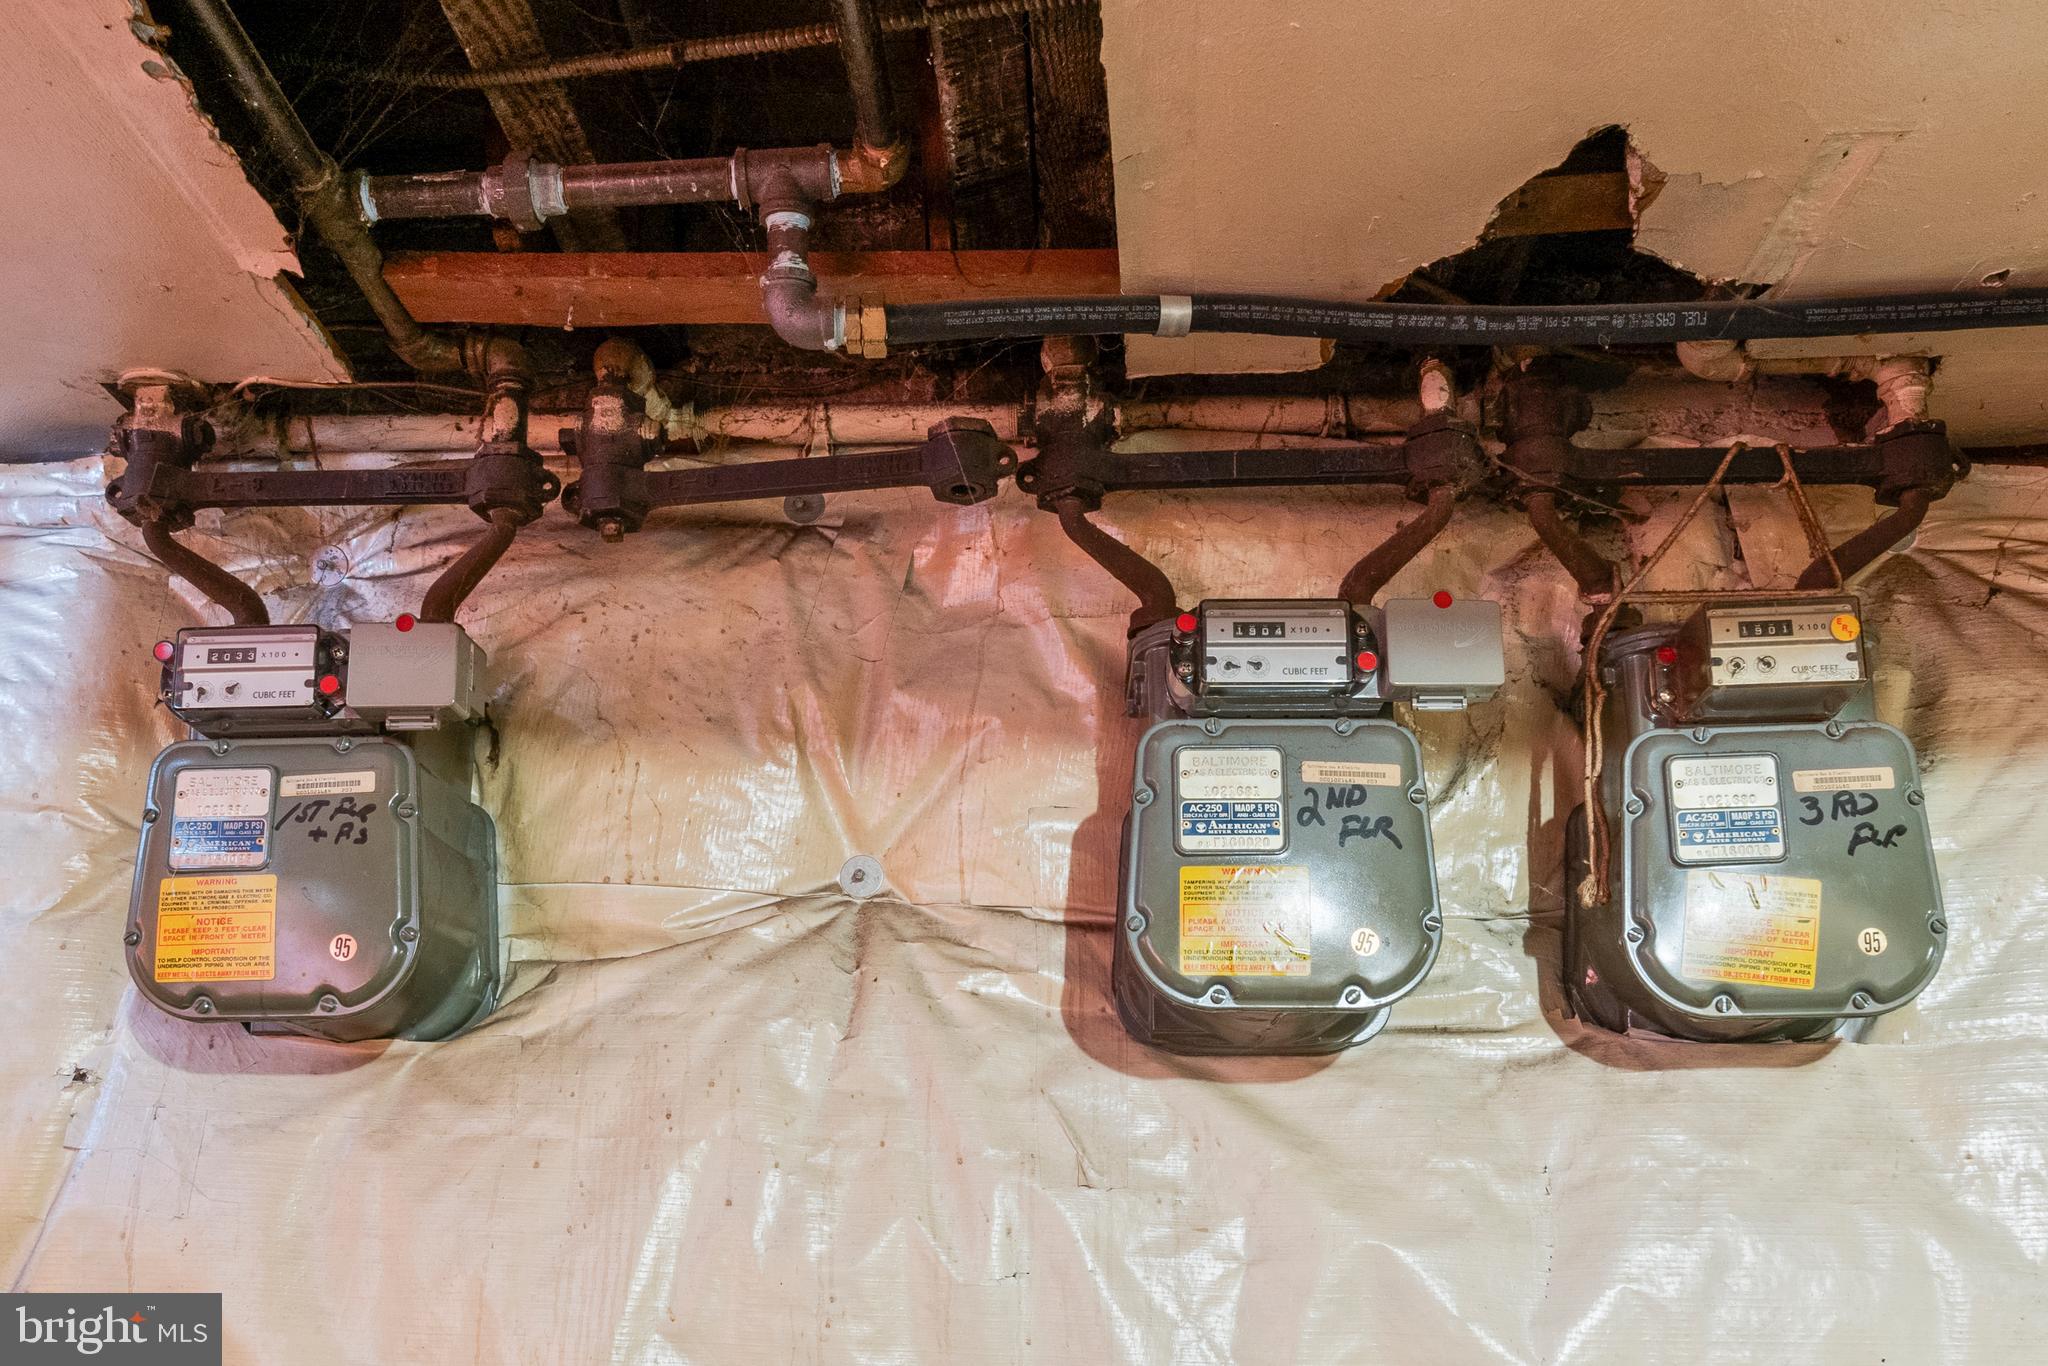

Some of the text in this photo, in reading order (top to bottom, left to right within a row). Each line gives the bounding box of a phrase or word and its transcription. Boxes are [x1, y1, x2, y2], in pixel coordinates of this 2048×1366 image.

[1544, 316, 1558, 328] PSI
[1655, 312, 1676, 327] GAS
[1682, 312, 1707, 326] FUEL
[1235, 626, 1282, 636] 1904
[212, 652, 255, 661] 2033
[1282, 667, 1329, 676] CUBIC FEET
[252, 690, 296, 699] CUBIC FEET
[1192, 756, 1268, 766] BALTIMORE
[1685, 764, 1763, 776] BALTIMORE
[1189, 804, 1223, 812] AC-250
[1234, 804, 1278, 812] MAOP 5 PSI
[1685, 813, 1719, 822] AC-250
[1731, 811, 1775, 820] MAOP 5 PSI
[182, 822, 213, 830] AC-250
[1208, 820, 1267, 829] AMERICAN
[1706, 830, 1766, 838] AMERICAN
[196, 917, 233, 925] NOTICE
[1784, 930, 1810, 938] CLEAR
[1355, 931, 1375, 953] 95
[1864, 932, 1881, 952] 95
[334, 937, 352, 958] 95
[1725, 948, 1775, 958] IMPORTANT
